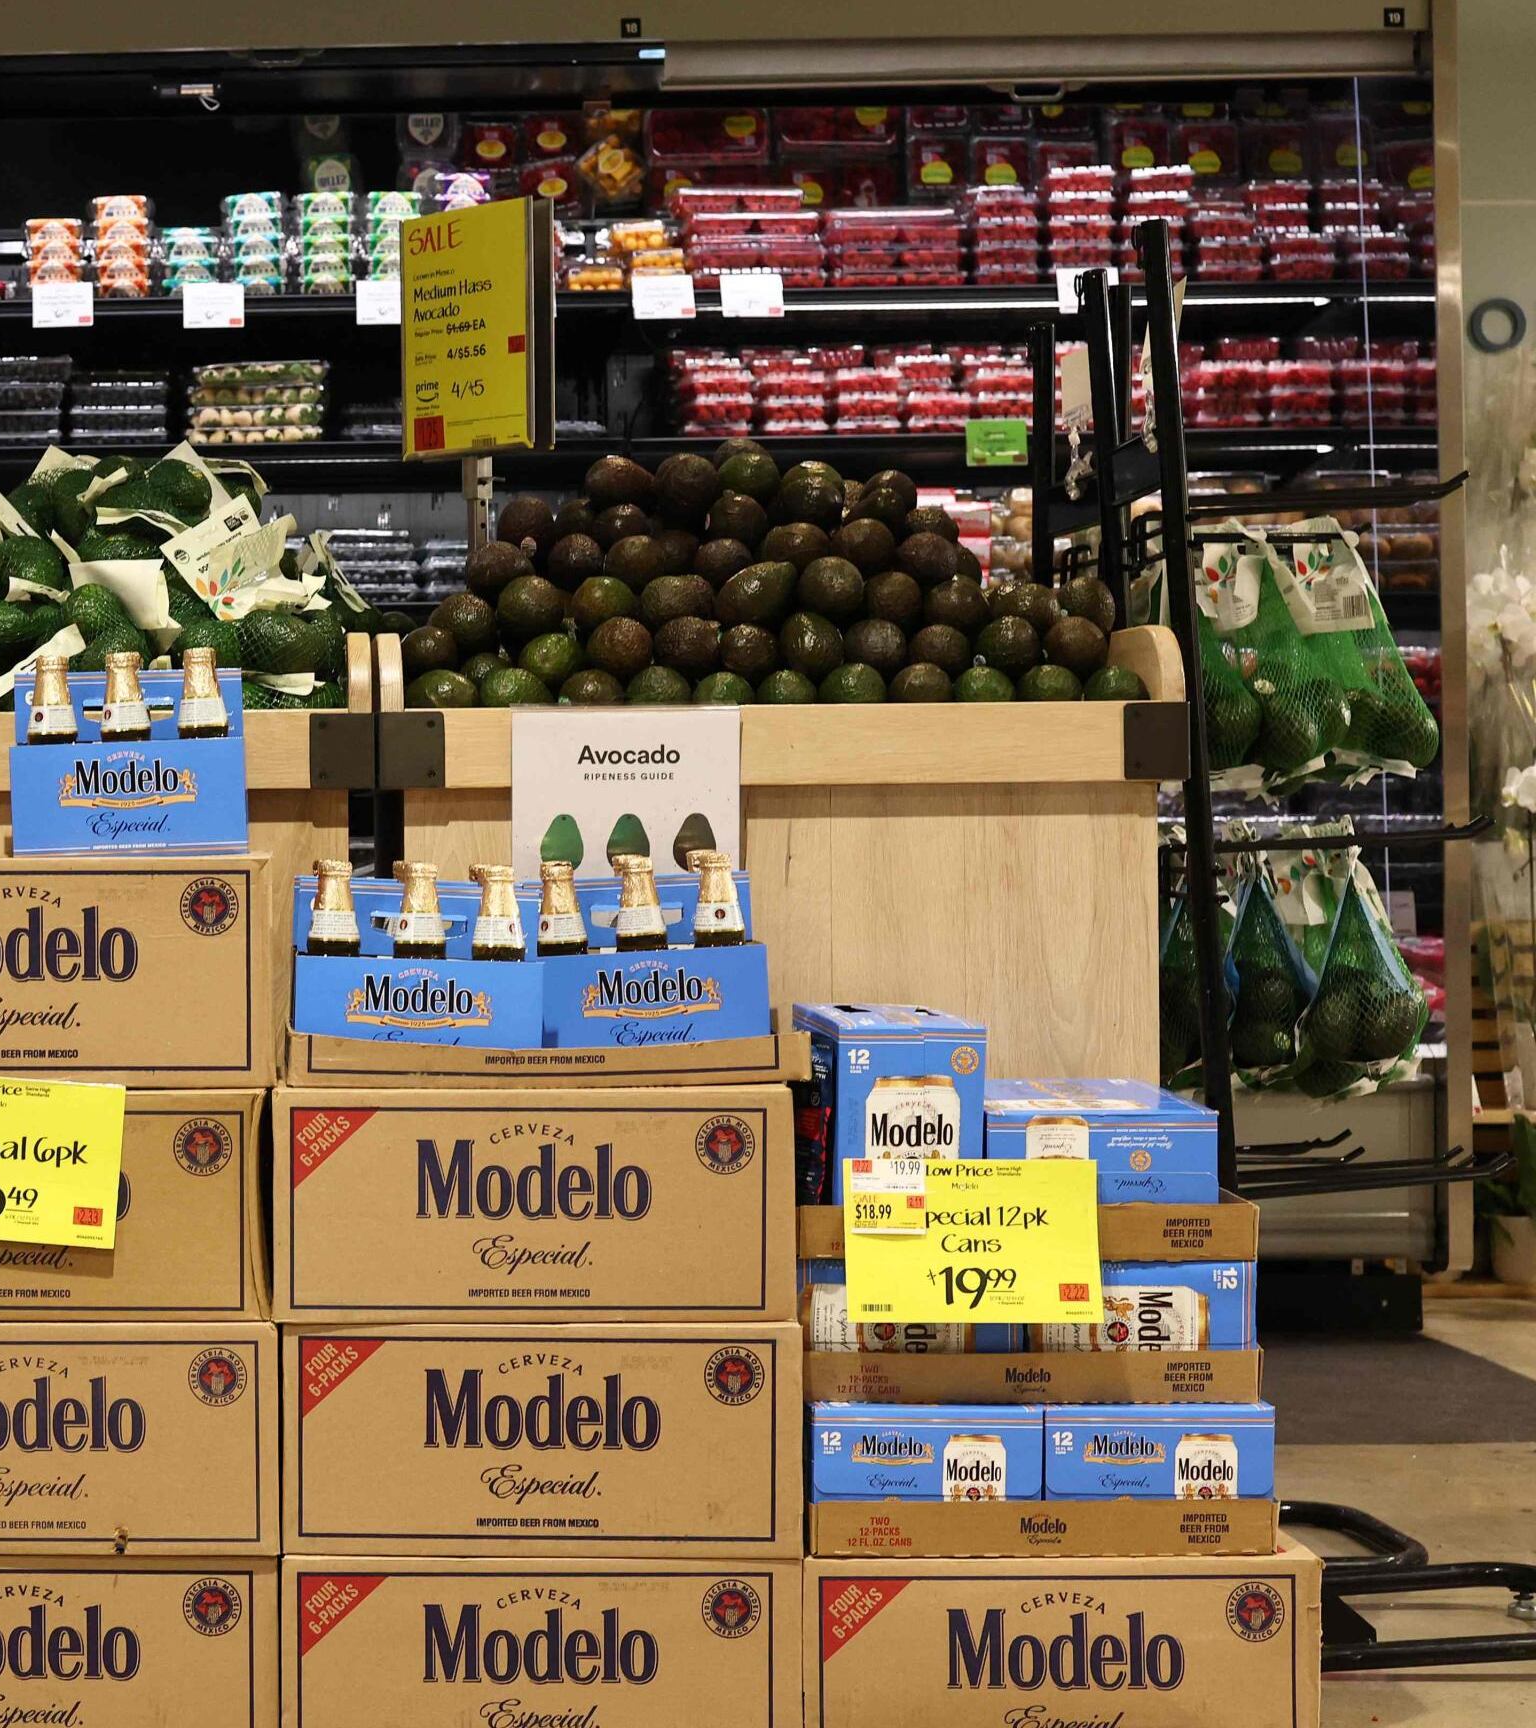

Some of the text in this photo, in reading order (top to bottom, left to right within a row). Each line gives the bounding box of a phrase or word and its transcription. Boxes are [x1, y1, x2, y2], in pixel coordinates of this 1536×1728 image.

[625, 22, 638, 34] 18
[1388, 12, 1402, 24] 19
[408, 219, 463, 256] SALE
[414, 279, 492, 302] Medium Hass
[414, 302, 460, 322] Avocado
[473, 318, 486, 330] EA
[447, 344, 486, 359] 4/$5.56
[416, 381, 439, 395] prime
[577, 744, 681, 766] Avocado
[74, 757, 180, 796] Modelo
[584, 772, 675, 782] RIPENESS GUIDE
[85, 811, 171, 841] Especial.
[363, 973, 473, 1016] Modelo
[597, 967, 704, 1007] Modelo
[1, 1049, 21, 1059] BEER
[23, 1049, 45, 1058] FROM
[48, 1049, 78, 1058] MEXICO
[847, 1049, 871, 1065] 12
[489, 1123, 576, 1147] CERVEZA
[870, 1111, 955, 1147] Modelo
[34, 1136, 88, 1168] 6pk
[415, 1138, 652, 1222] Modelo
[889, 1161, 993, 1178] $19.99 Low Price
[855, 1204, 892, 1221] $18.99
[998, 1206, 1049, 1230] 12pk
[1166, 1217, 1210, 1228] IMPORTED
[941, 1233, 1003, 1254] Cans
[1163, 1228, 1213, 1238] BEER FROM
[1171, 1239, 1204, 1249] MEXICO
[472, 1234, 593, 1275] Especial.
[423, 1367, 662, 1451] Modelo
[820, 1431, 923, 1458] 12 Modelo
[1052, 1431, 1155, 1457] 12 Modelo
[946, 1457, 1002, 1482] Modelo
[1178, 1457, 1234, 1481] Modelo
[480, 1464, 602, 1505] Especial.
[1020, 1592, 1107, 1614] CERVEZA
[422, 1603, 659, 1685] Modelo
[945, 1608, 1185, 1691] Modelo
